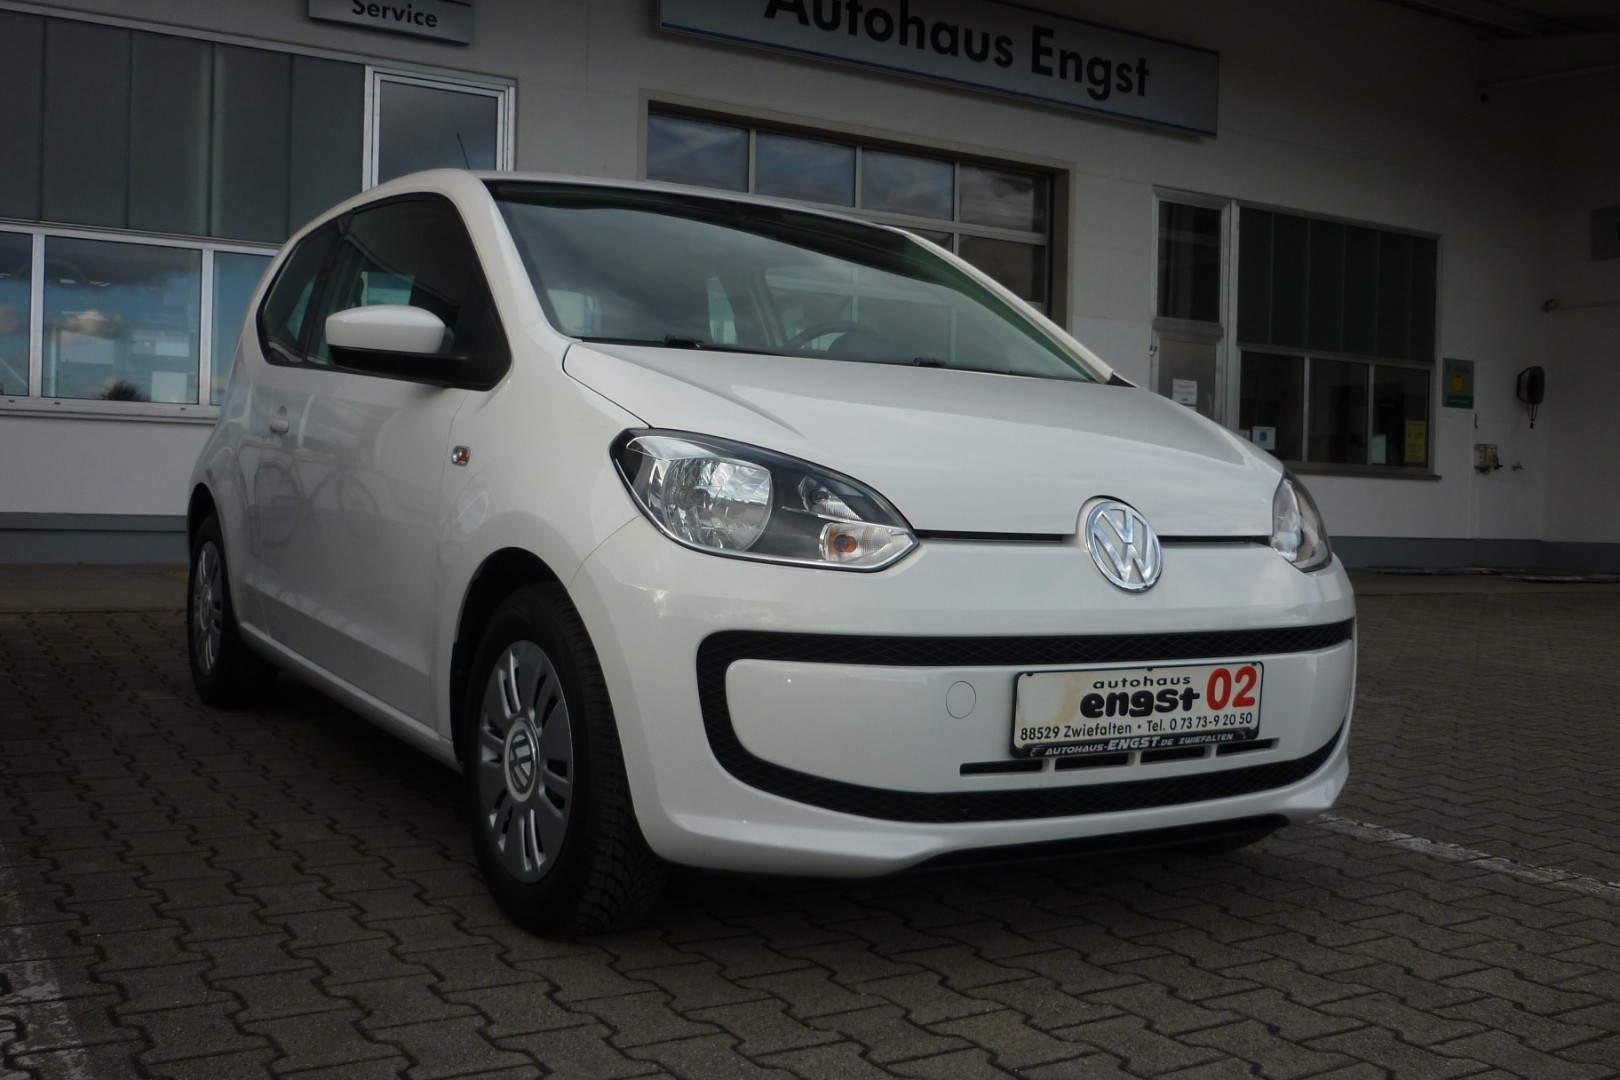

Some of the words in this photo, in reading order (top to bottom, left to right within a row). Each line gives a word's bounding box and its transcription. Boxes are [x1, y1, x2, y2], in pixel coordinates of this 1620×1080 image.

[352, 0, 438, 28] Service
[1031, 25, 1150, 101] Engst
[1080, 687, 1201, 719] engst
[1206, 665, 1257, 711] 02
[1092, 676, 1192, 690] autohaus
[1020, 726, 1060, 741] 88529
[1063, 721, 1132, 739] Zwiefalten
[1146, 718, 1166, 733] Tel.
